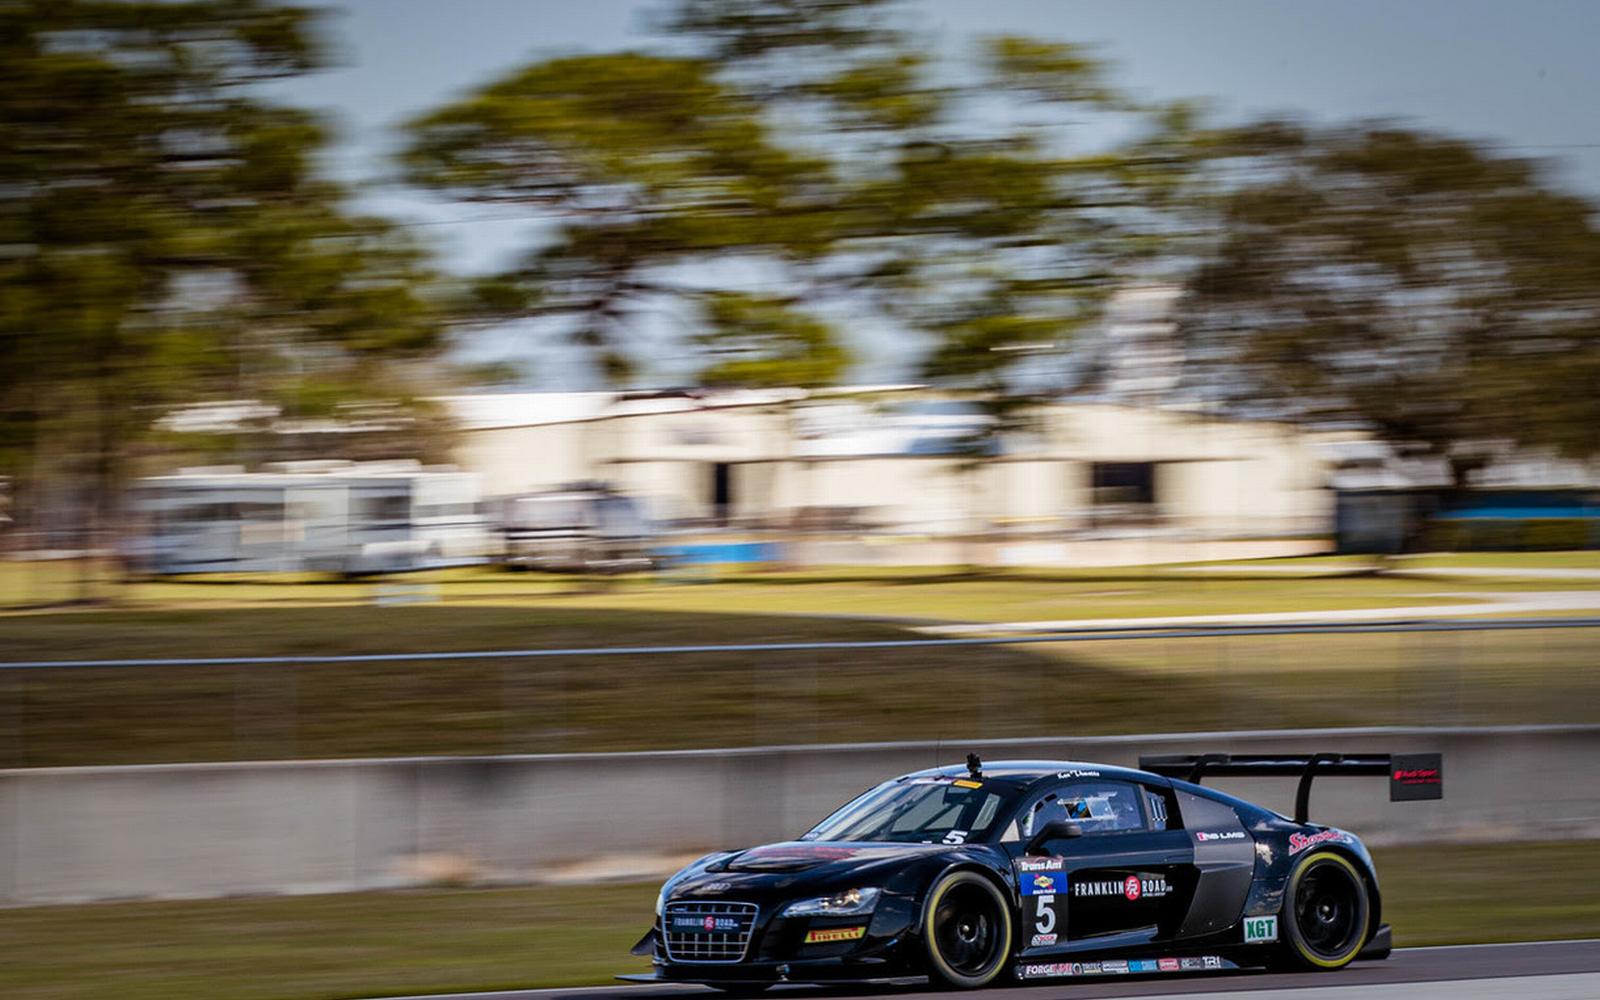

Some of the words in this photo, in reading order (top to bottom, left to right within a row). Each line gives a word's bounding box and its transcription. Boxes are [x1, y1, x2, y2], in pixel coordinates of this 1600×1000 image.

[942, 830, 968, 844] 5
[1075, 881, 1124, 896] FRANKLIN
[1142, 879, 1166, 892] ROAD
[1035, 895, 1056, 934] 5
[810, 928, 861, 941] PIRELLI
[1247, 919, 1274, 938] XGT
[1202, 956, 1220, 966] TRI
